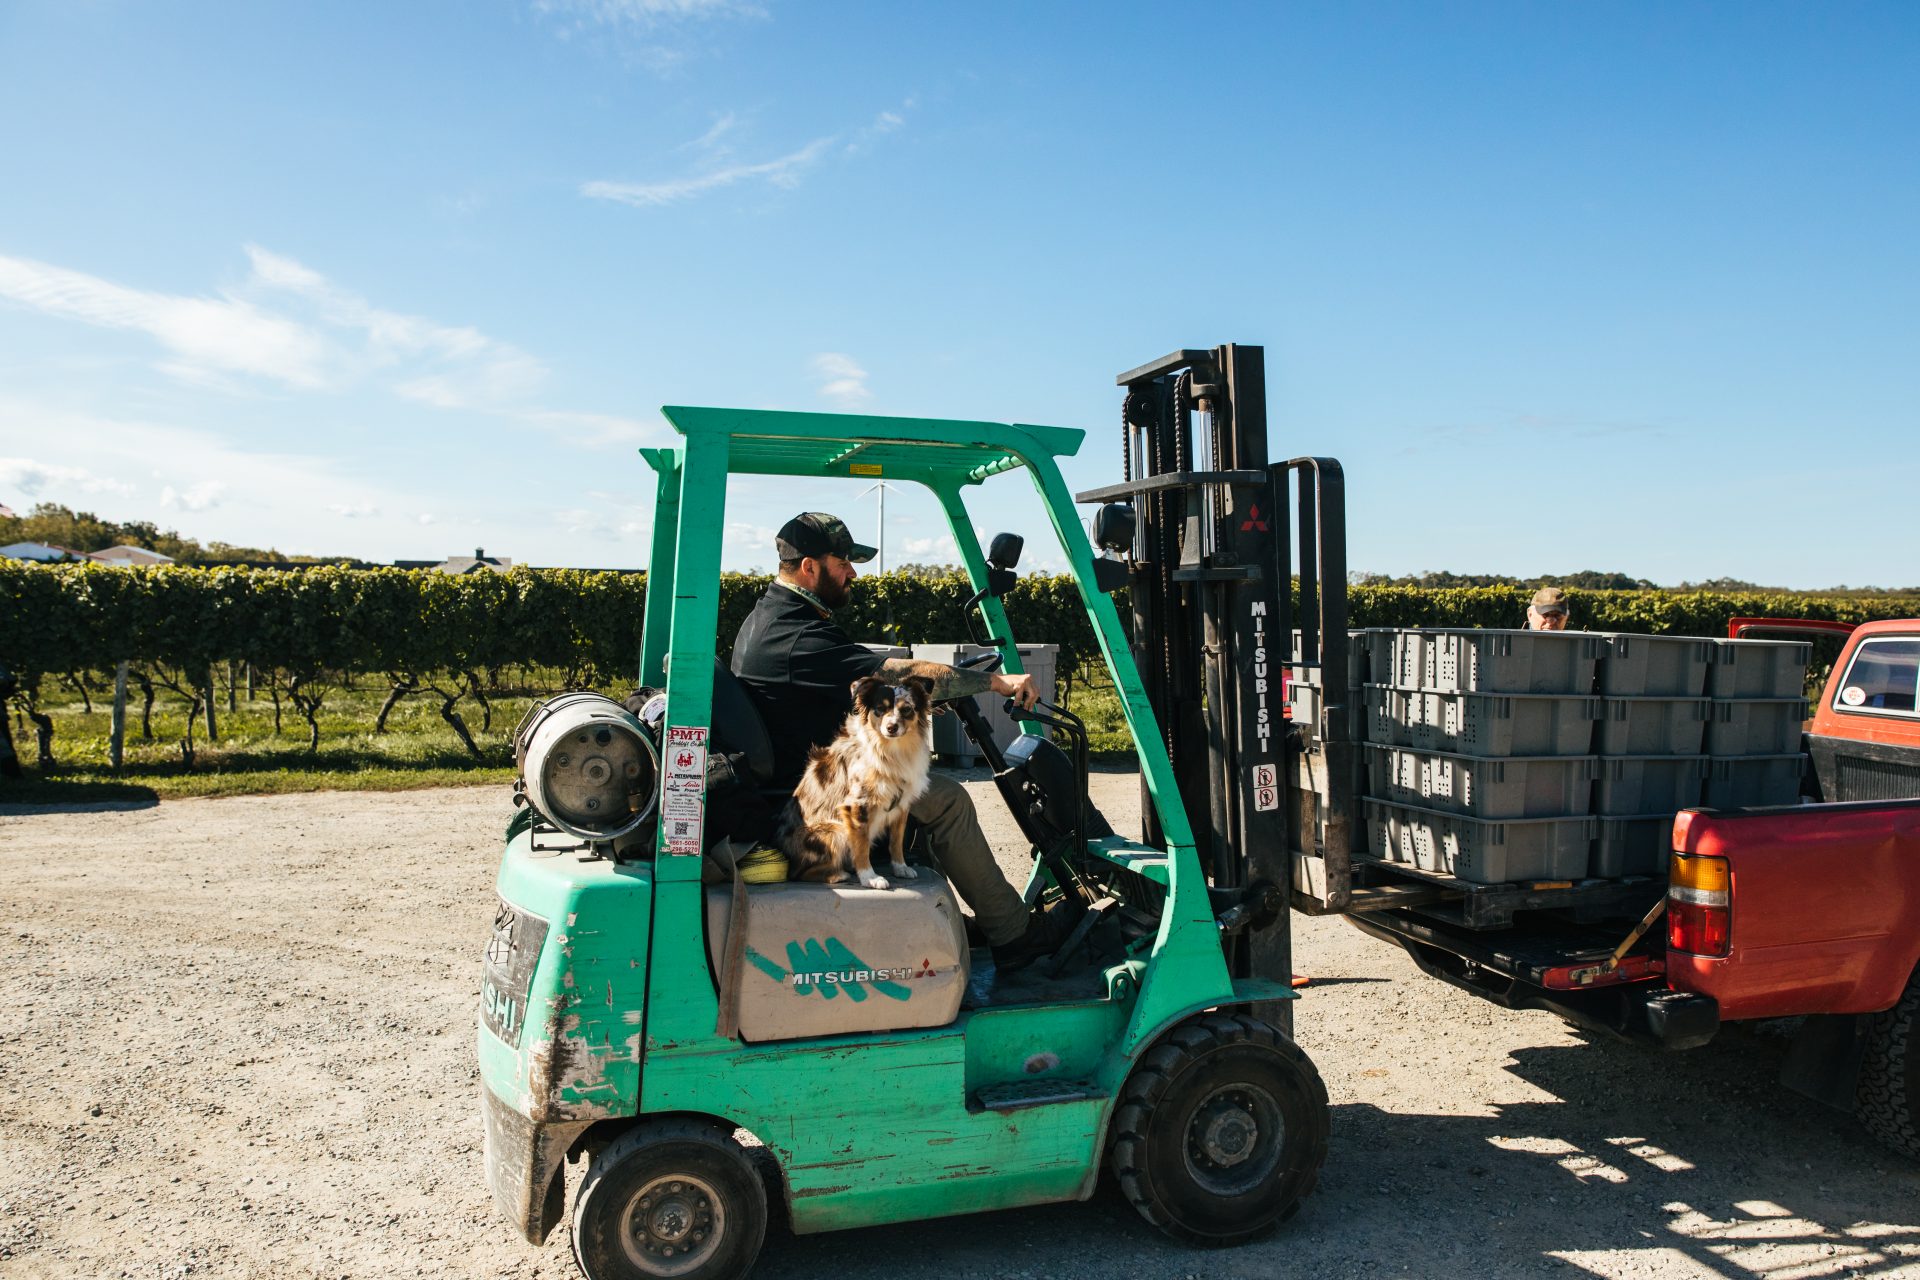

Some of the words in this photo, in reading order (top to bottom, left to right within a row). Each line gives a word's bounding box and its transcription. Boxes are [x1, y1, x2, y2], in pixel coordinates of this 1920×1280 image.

[1251, 601, 1270, 753] MITSUBISHI
[670, 730, 705, 740] PMT
[784, 967, 913, 986] MITSUBISHI
